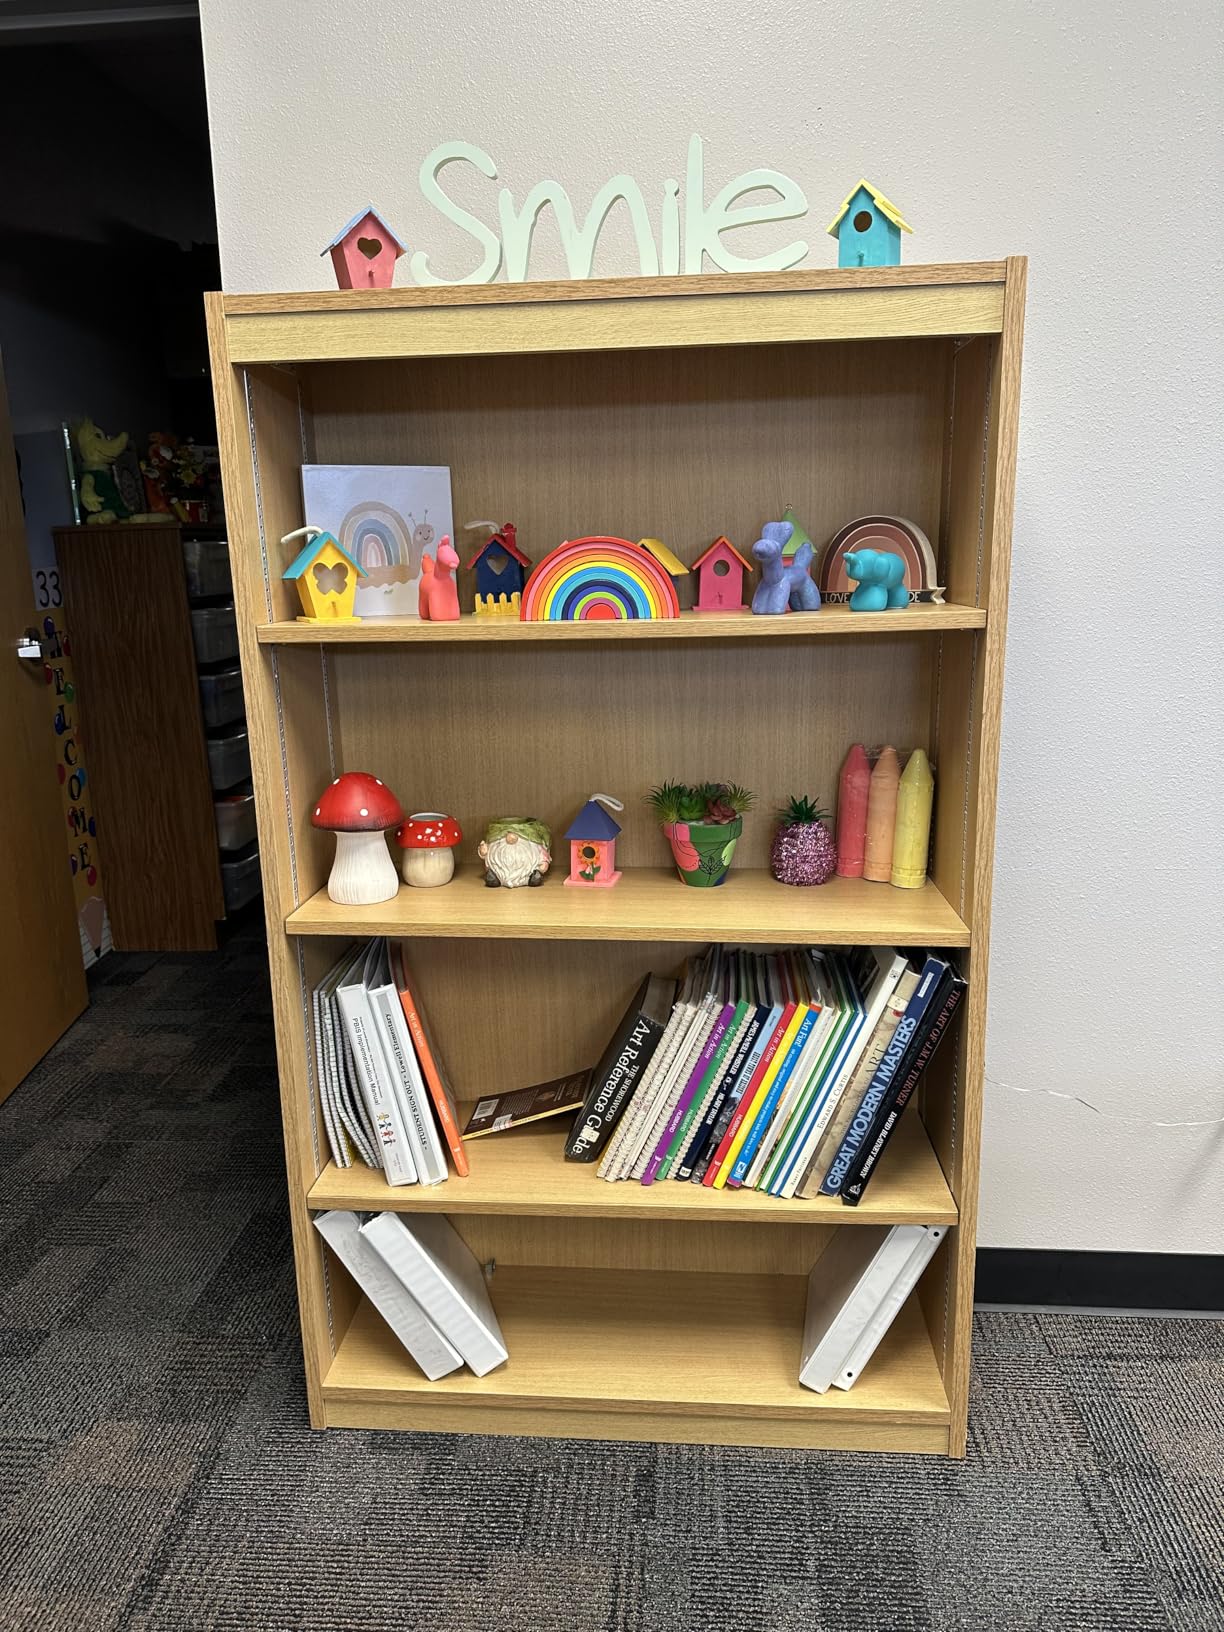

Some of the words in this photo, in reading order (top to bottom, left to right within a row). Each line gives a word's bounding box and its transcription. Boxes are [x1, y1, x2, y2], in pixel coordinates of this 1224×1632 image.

[410, 132, 810, 286] Smile
[825, 592, 850, 603] LOVE
[943, 987, 961, 1010] THE
[351, 1017, 361, 1033] PBIS
[715, 1022, 726, 1035] Art
[726, 1022, 737, 1034] Art
[746, 1019, 760, 1037] JAMES
[800, 1017, 813, 1032] Art
[934, 1008, 951, 1029] ART
[384, 1012, 400, 1051] Elementary
[628, 1018, 653, 1047] Art
[712, 1032, 721, 1041] in
[772, 1035, 780, 1044] in
[774, 1024, 785, 1038] Art
[793, 1030, 807, 1048] Fun!
[927, 1026, 941, 1043] OF
[355, 1033, 375, 1083] Implementation
[703, 1039, 718, 1060] Action
[714, 1040, 728, 1060] Action
[763, 1043, 777, 1063] Action
[863, 1042, 887, 1077] ART
[394, 1050, 406, 1073] Lowell
[626, 1062, 640, 1080] THE
[728, 1051, 745, 1075] WHISTLER
[403, 1079, 413, 1095] OUT
[592, 1043, 639, 1116] Reference
[831, 1072, 849, 1097] CURTIS
[893, 1067, 920, 1107] TURNER
[368, 1082, 380, 1106] Manual
[407, 1094, 418, 1113] SIGN
[603, 1076, 632, 1123] SHOREWOOD
[823, 1142, 858, 1191] GREAT
[844, 1080, 887, 1147] MODERN
[874, 1013, 919, 1082] MASTERS
[828, 1095, 837, 1104] S.
[667, 1108, 683, 1133] HUBBARD
[679, 1108, 694, 1132] HUBBARD
[727, 1112, 743, 1138] HUBBARD
[816, 1102, 834, 1129] EDWARD
[882, 1110, 898, 1130] DAVID
[413, 1112, 427, 1145] STUDENT
[570, 1112, 604, 1157] Gde
[869, 1127, 889, 1157] BLAYNEY
[858, 1154, 875, 1179] BROWN
